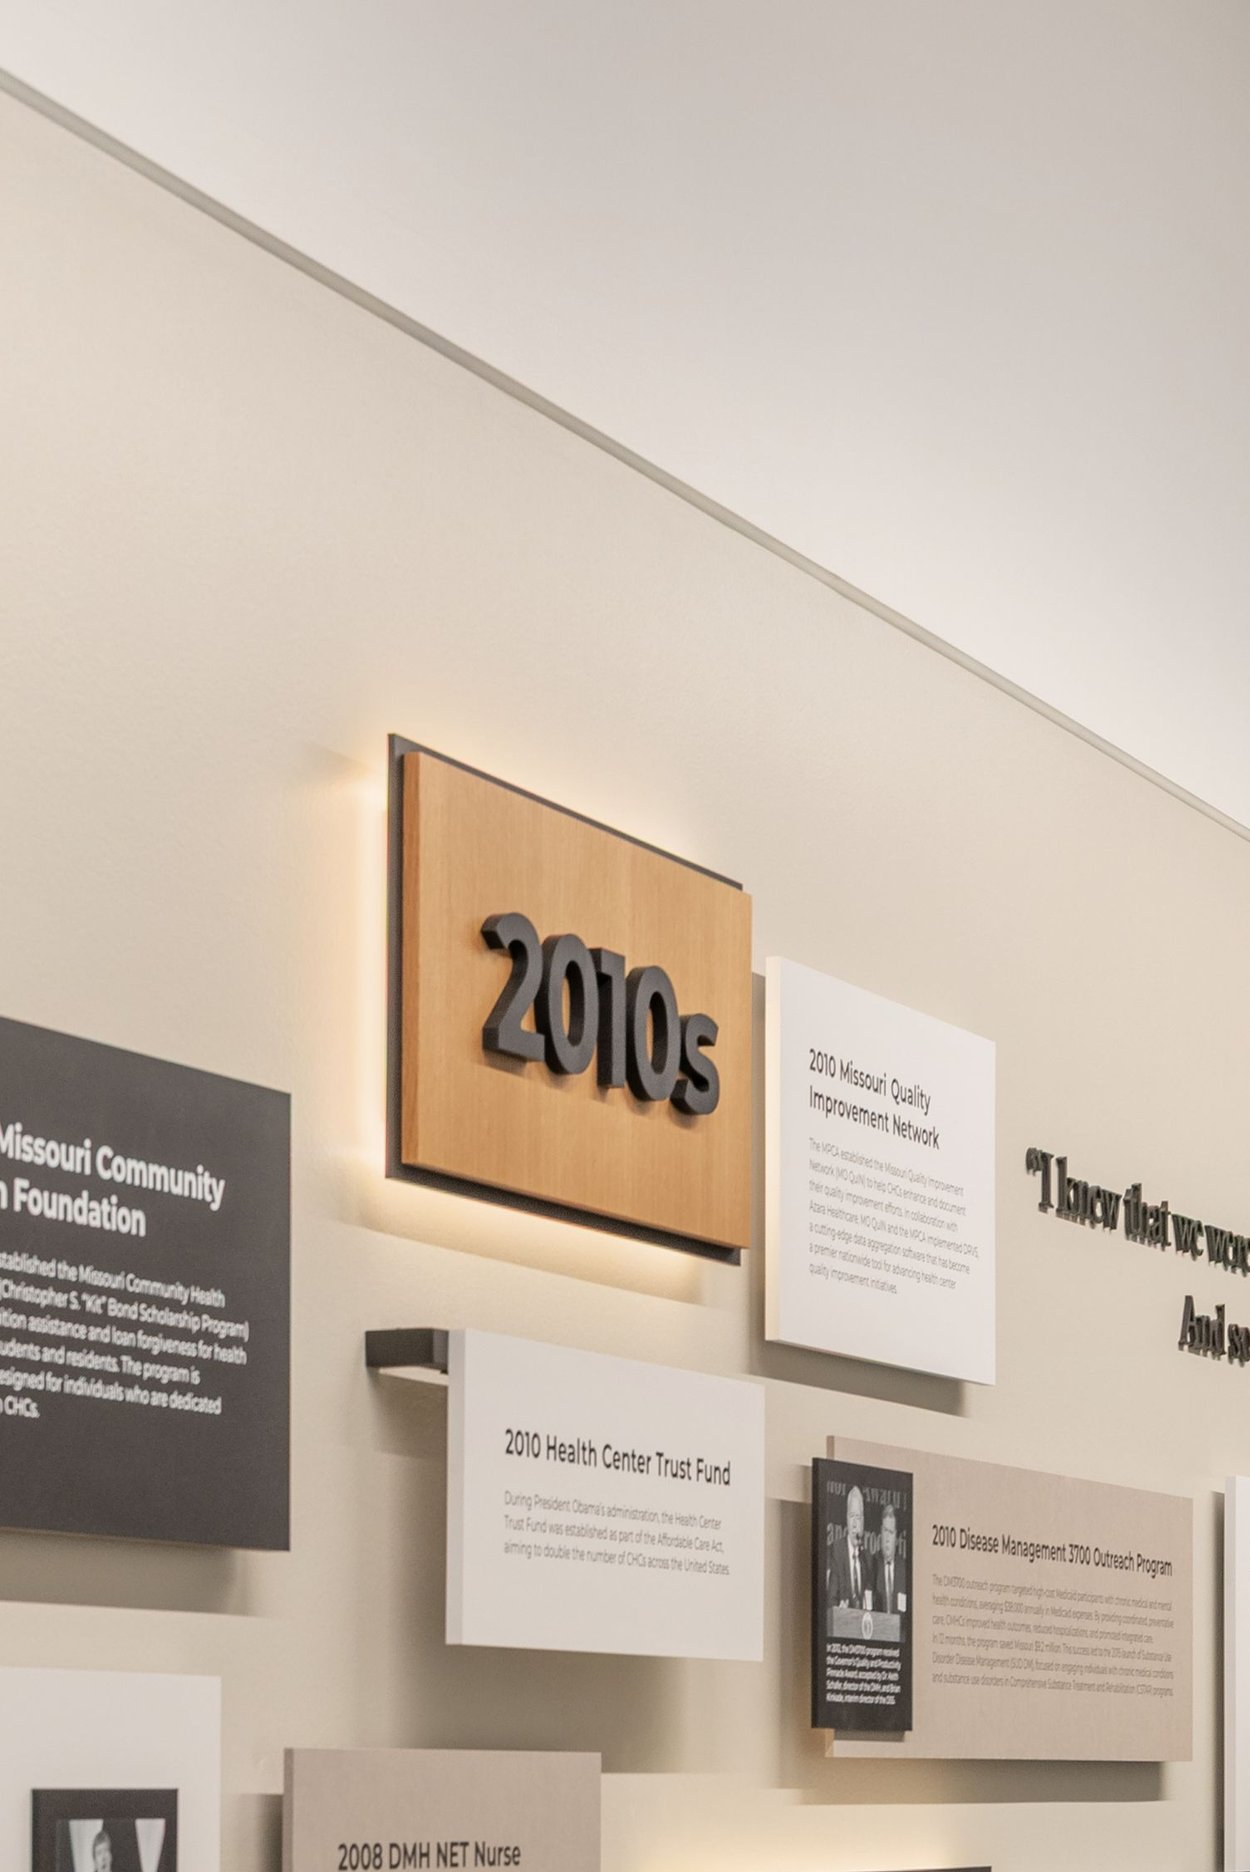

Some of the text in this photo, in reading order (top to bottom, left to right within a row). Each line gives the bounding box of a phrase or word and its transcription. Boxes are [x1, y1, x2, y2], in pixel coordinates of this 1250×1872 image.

[481, 912, 720, 1115] 2010s
[810, 1048, 930, 1116] 2010 Missouri Quality
[810, 1085, 939, 1149] Improvement Network
[0, 1122, 225, 1211] Missouri Community
[14, 1178, 146, 1237] Foundation
[1056, 1156, 1122, 1229] knew
[1123, 1183, 1171, 1249] that
[1172, 1214, 1204, 1260] we
[55, 1260, 225, 1308] the Missouri Community Health
[1178, 1295, 1226, 1360] And
[506, 1429, 730, 1485] 2010 Health Center Trust Fund
[932, 1524, 1172, 1578] 2010 Disease Management 3700 Outreach Program
[338, 1842, 521, 1871] 2008 DMH NET Nurse
